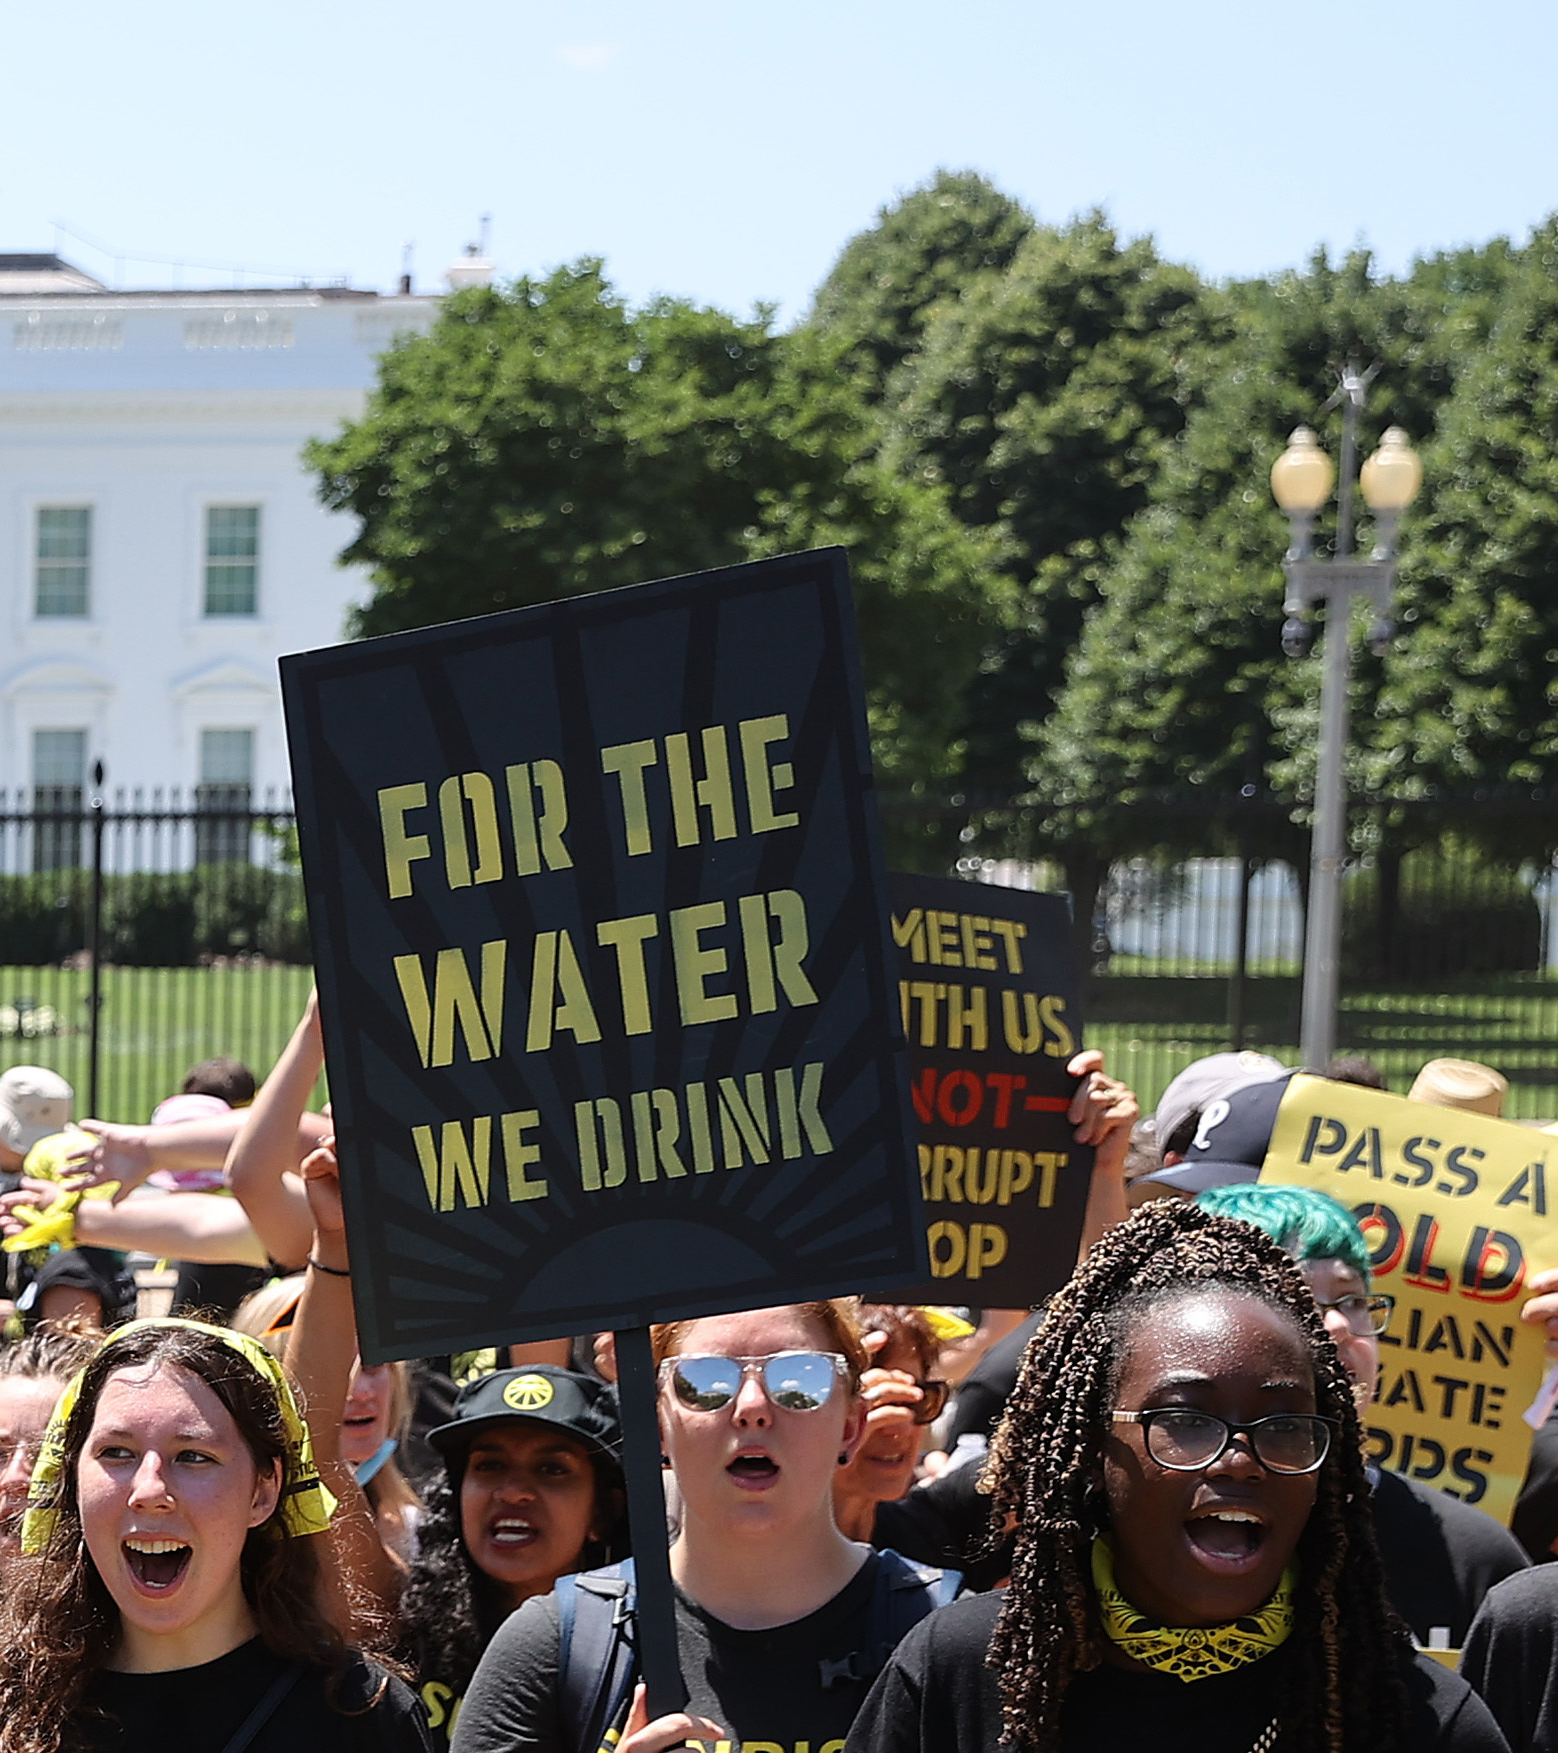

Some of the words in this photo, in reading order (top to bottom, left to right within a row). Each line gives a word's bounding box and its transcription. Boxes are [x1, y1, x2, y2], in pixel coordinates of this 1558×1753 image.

[377, 758, 574, 900] FOR
[601, 713, 801, 857] THE
[394, 889, 820, 1070] WATER
[992, 989, 1075, 1058] US
[411, 1108, 549, 1214] WE
[574, 1061, 833, 1194] DRINK
[1300, 1114, 1485, 1196] PASS
[1496, 1159, 1549, 1217] A
